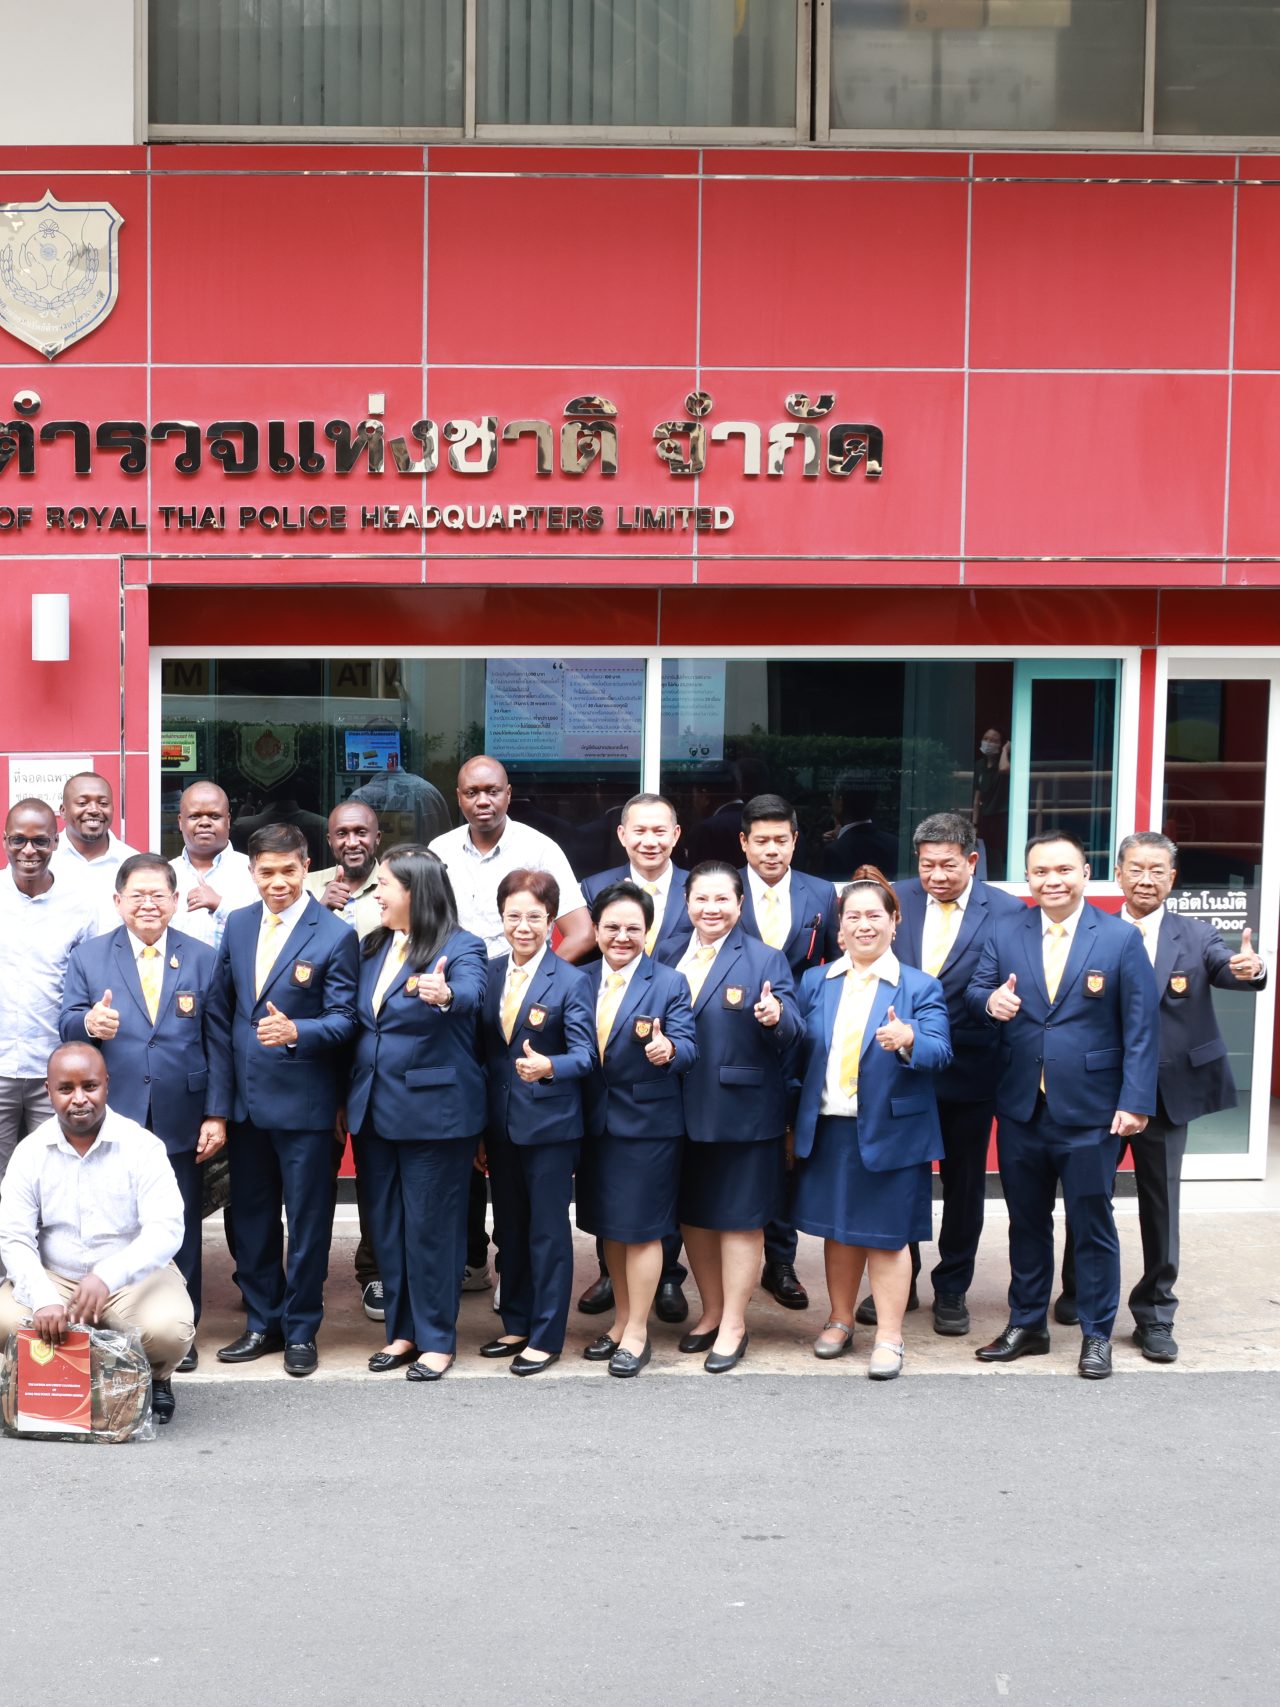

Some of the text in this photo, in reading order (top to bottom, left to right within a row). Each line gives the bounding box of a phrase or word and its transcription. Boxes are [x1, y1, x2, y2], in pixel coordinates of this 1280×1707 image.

[652, 391, 884, 478] จำกัด
[46, 505, 147, 531] ROYAL
[158, 505, 226, 530] THAI
[238, 505, 348, 530] POLICE
[360, 504, 604, 530] HEADQUARTERS
[616, 505, 736, 530] LIMITED
[1211, 917, 1247, 930] Door
